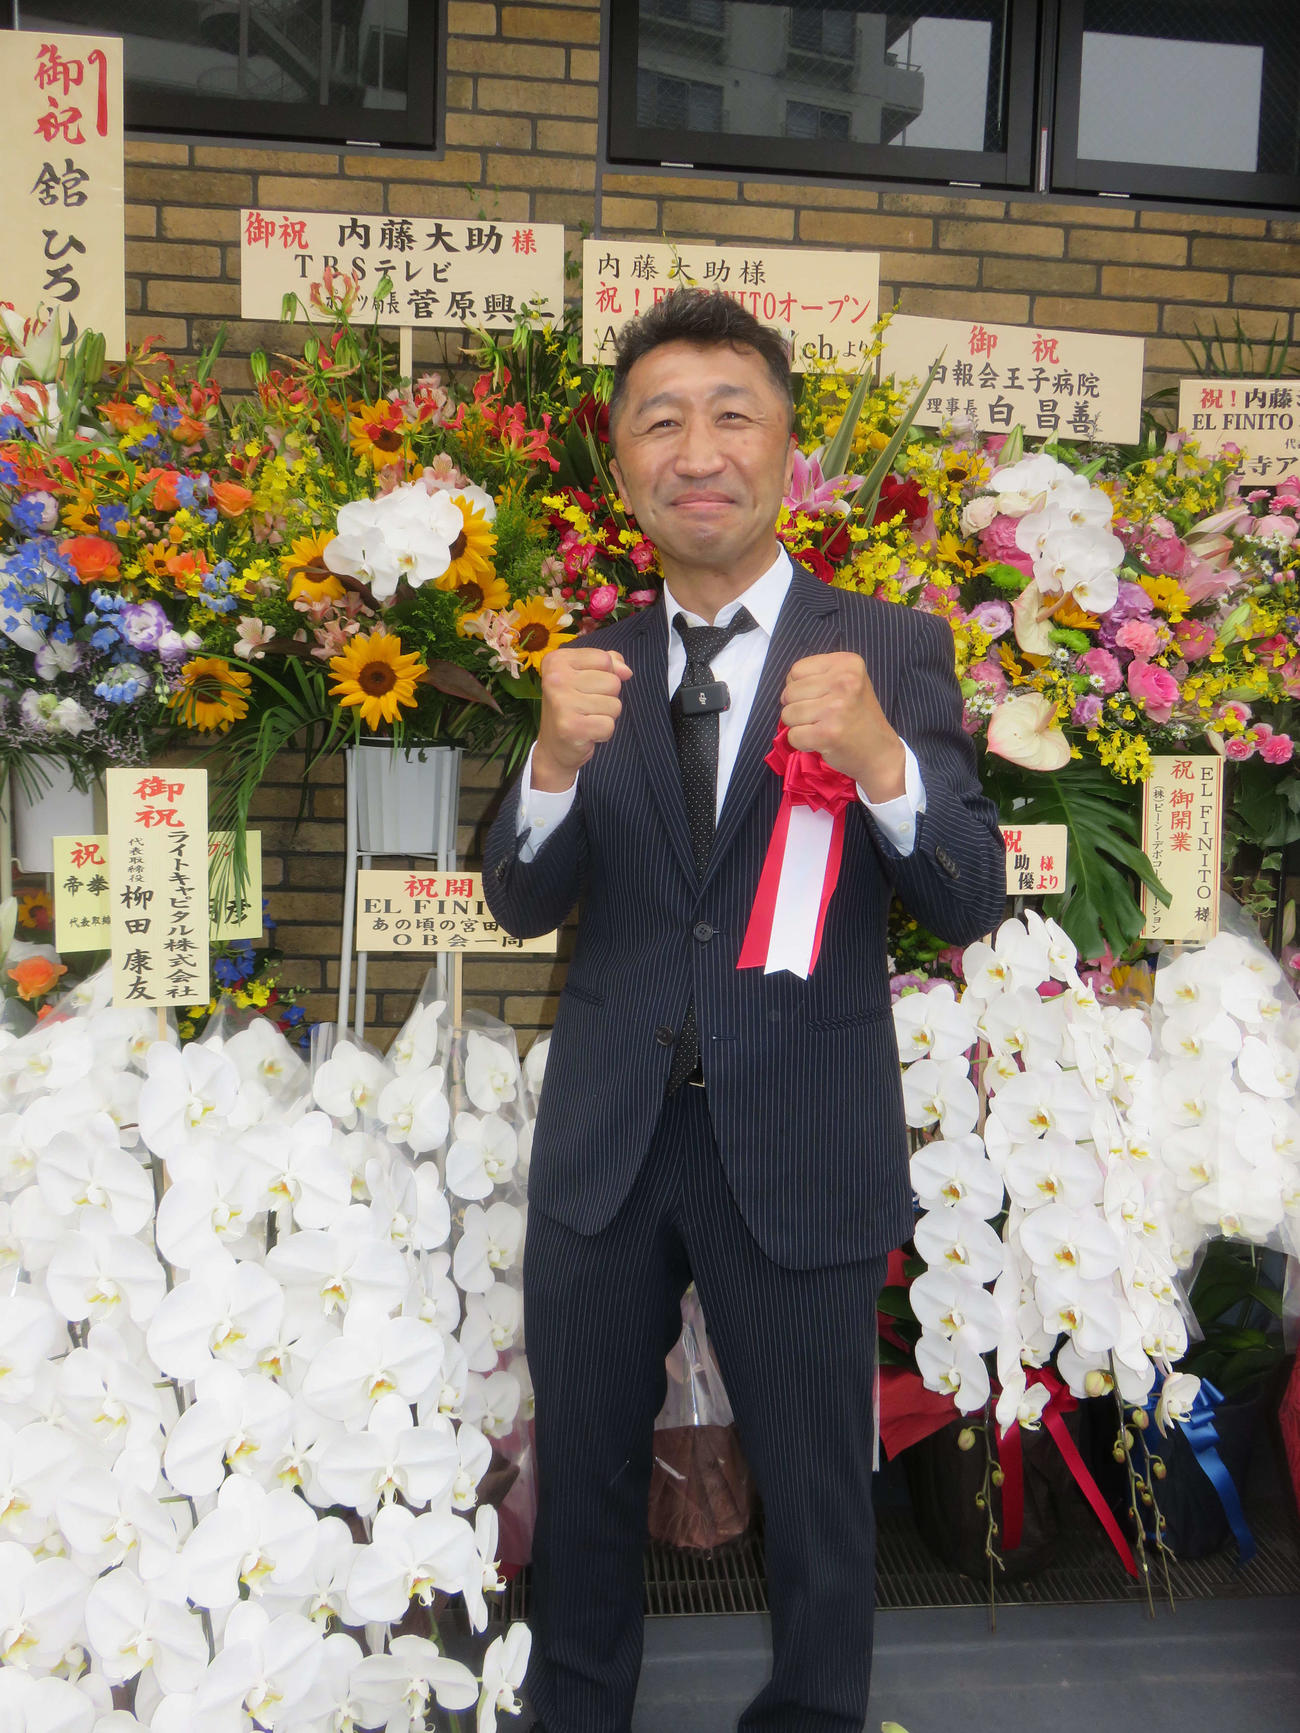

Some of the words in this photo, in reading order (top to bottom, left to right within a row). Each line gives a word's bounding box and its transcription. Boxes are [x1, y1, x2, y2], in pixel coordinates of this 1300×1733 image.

[34, 44, 86, 145] 御祝
[244, 211, 309, 250] 御祝
[598, 253, 766, 286] 内藤大助様
[968, 325, 1060, 365] 御祝
[1192, 413, 1217, 430] EL
[1222, 413, 1294, 431] FINITO
[132, 775, 186, 829] 御祝
[163, 830, 200, 999] ライトキャピタル株式会社
[364, 898, 402, 914] EL
[119, 884, 158, 1001] 柳田康友
